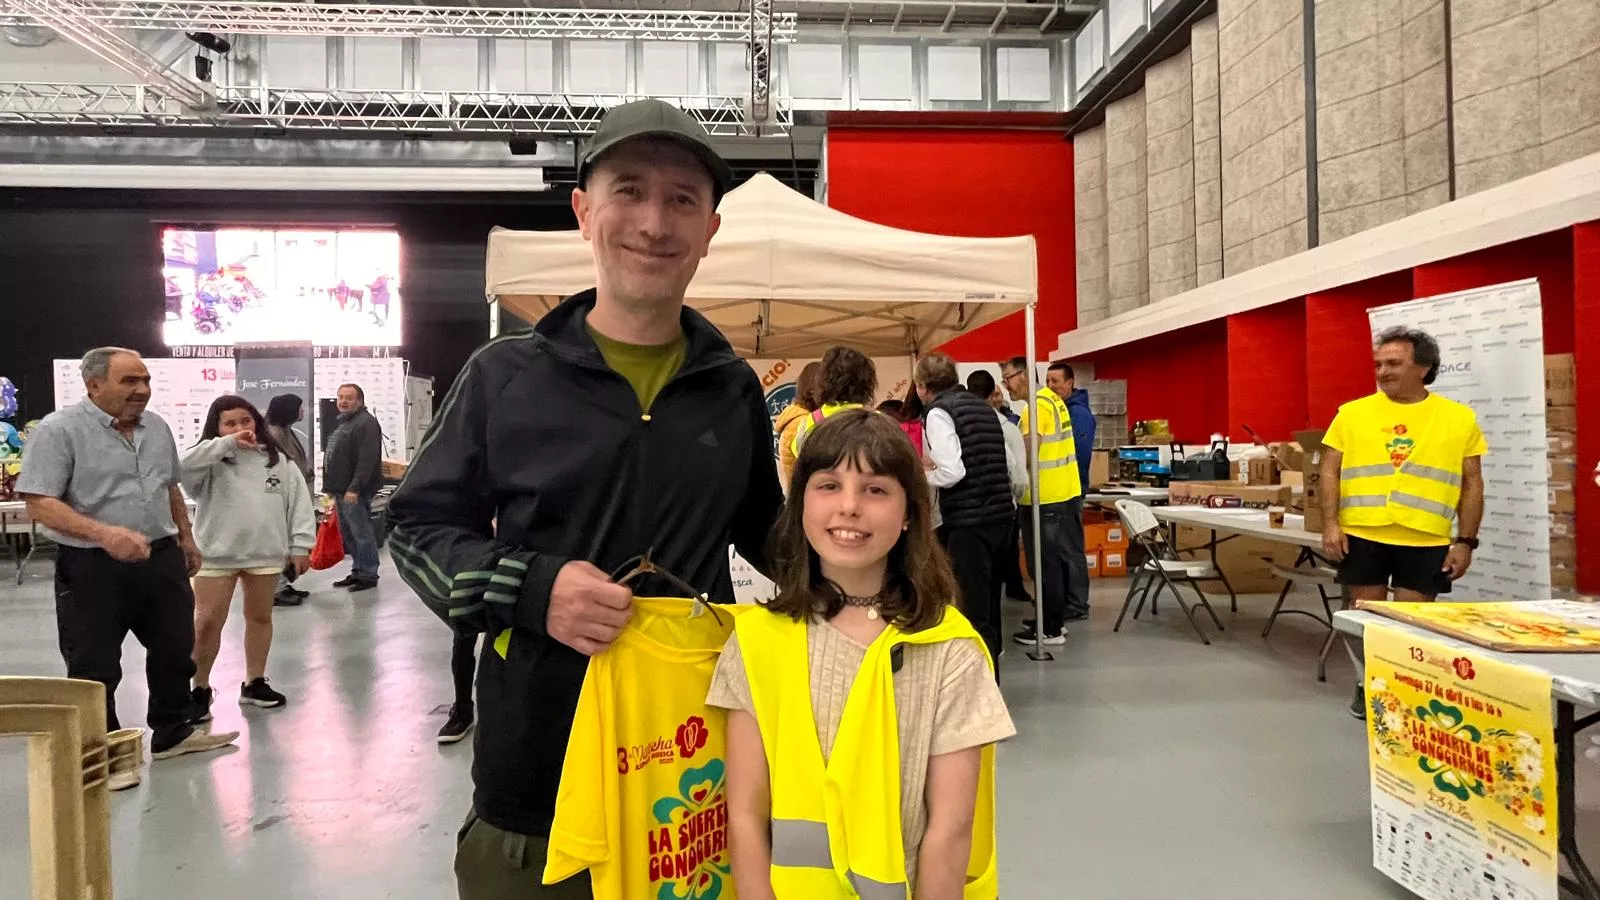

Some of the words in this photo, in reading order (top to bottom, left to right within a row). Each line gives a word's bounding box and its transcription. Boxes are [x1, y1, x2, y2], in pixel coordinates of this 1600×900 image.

[201, 368, 217, 381] 13
[761, 357, 791, 388] CIO!
[1408, 646, 1425, 663] 13
[1424, 679, 1433, 694] 27
[1434, 684, 1444, 698] de
[1445, 688, 1463, 705] abril
[1412, 719, 1427, 739] LA
[1429, 727, 1473, 759] SUERTE
[1476, 746, 1491, 767] DE
[617, 746, 630, 775] 3
[1412, 736, 1494, 783] CONOCERNOS
[648, 827, 673, 855] LA
[649, 829, 728, 882] CONOCER
